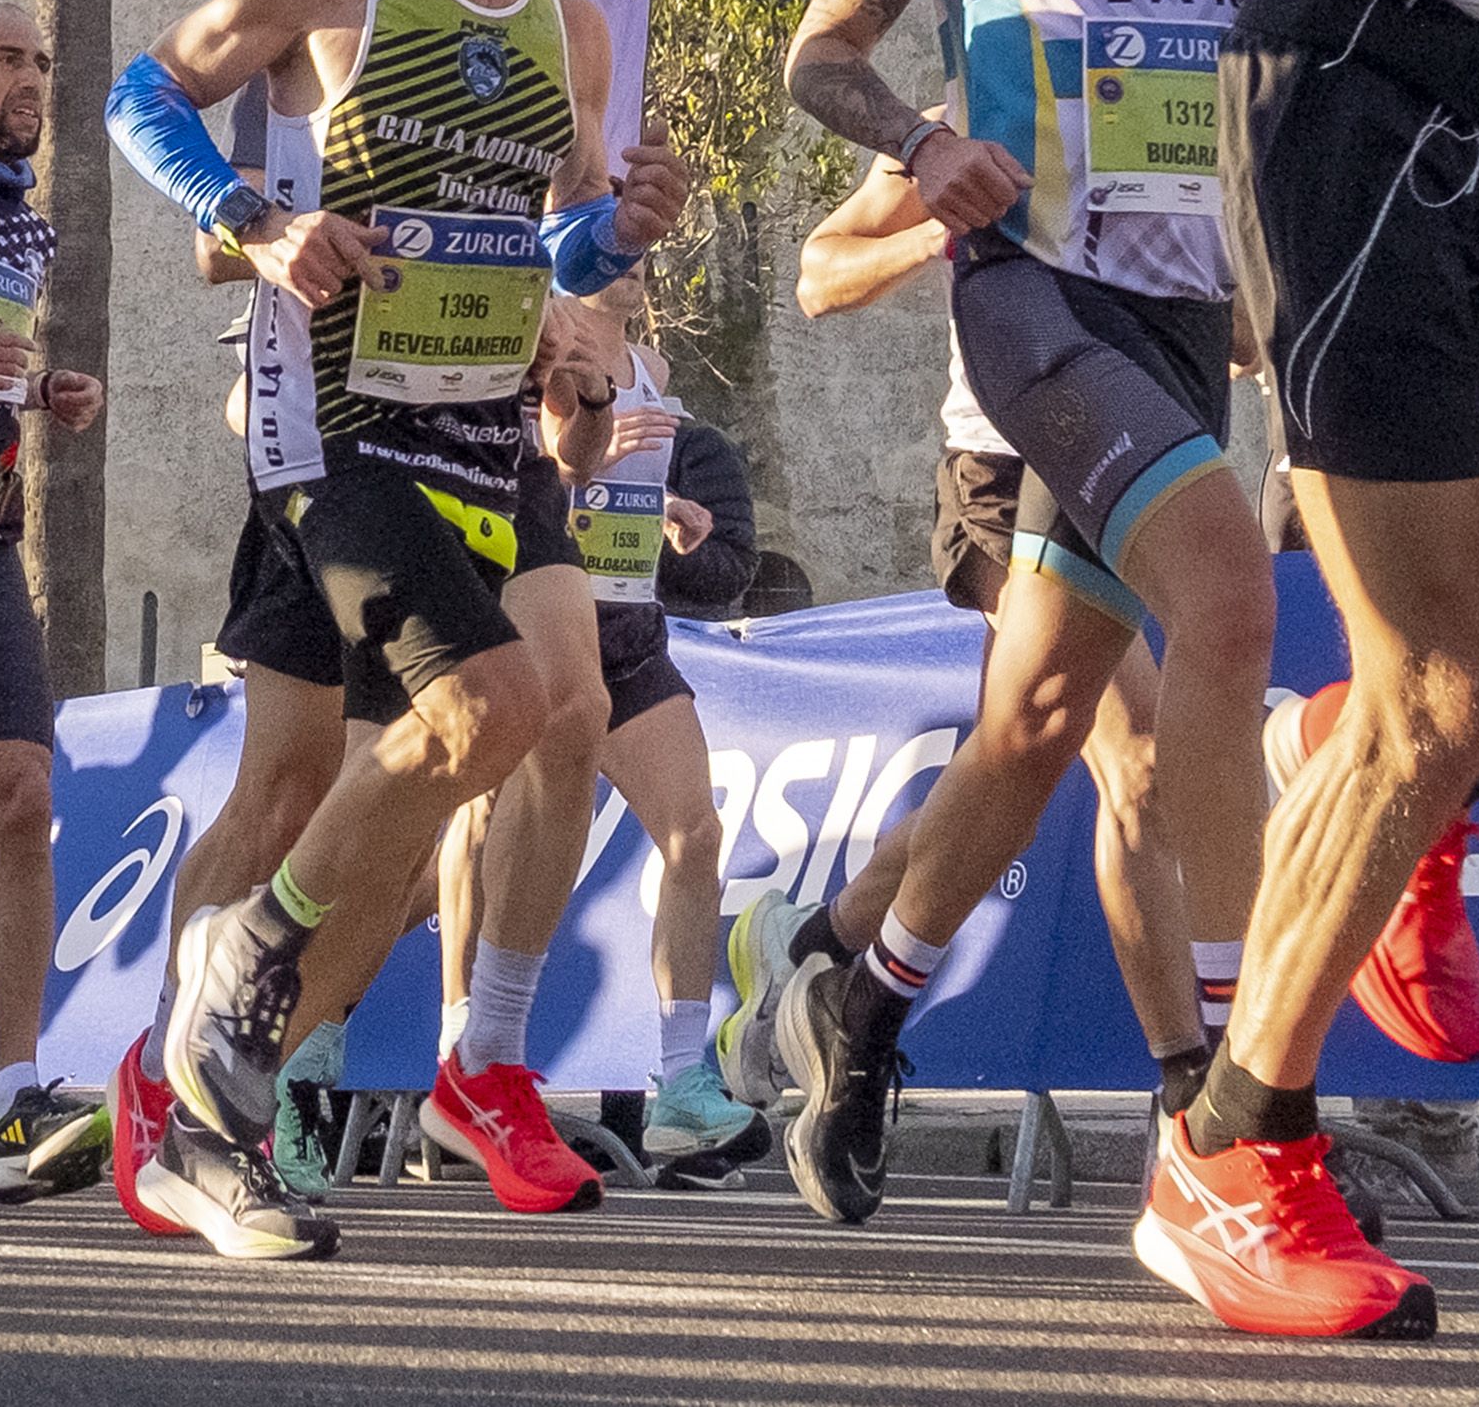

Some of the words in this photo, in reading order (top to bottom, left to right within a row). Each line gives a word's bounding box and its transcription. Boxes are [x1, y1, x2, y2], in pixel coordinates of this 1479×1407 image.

[1157, 37, 1219, 62] ZURI
[1161, 98, 1215, 129] 1312
[376, 113, 424, 147] C.D.
[432, 124, 466, 154] LA
[445, 231, 537, 257] ZURICH
[438, 293, 490, 319] 1396
[614, 491, 659, 510] ZURICH
[611, 530, 641, 549] 1538
[639, 726, 958, 917] asic
